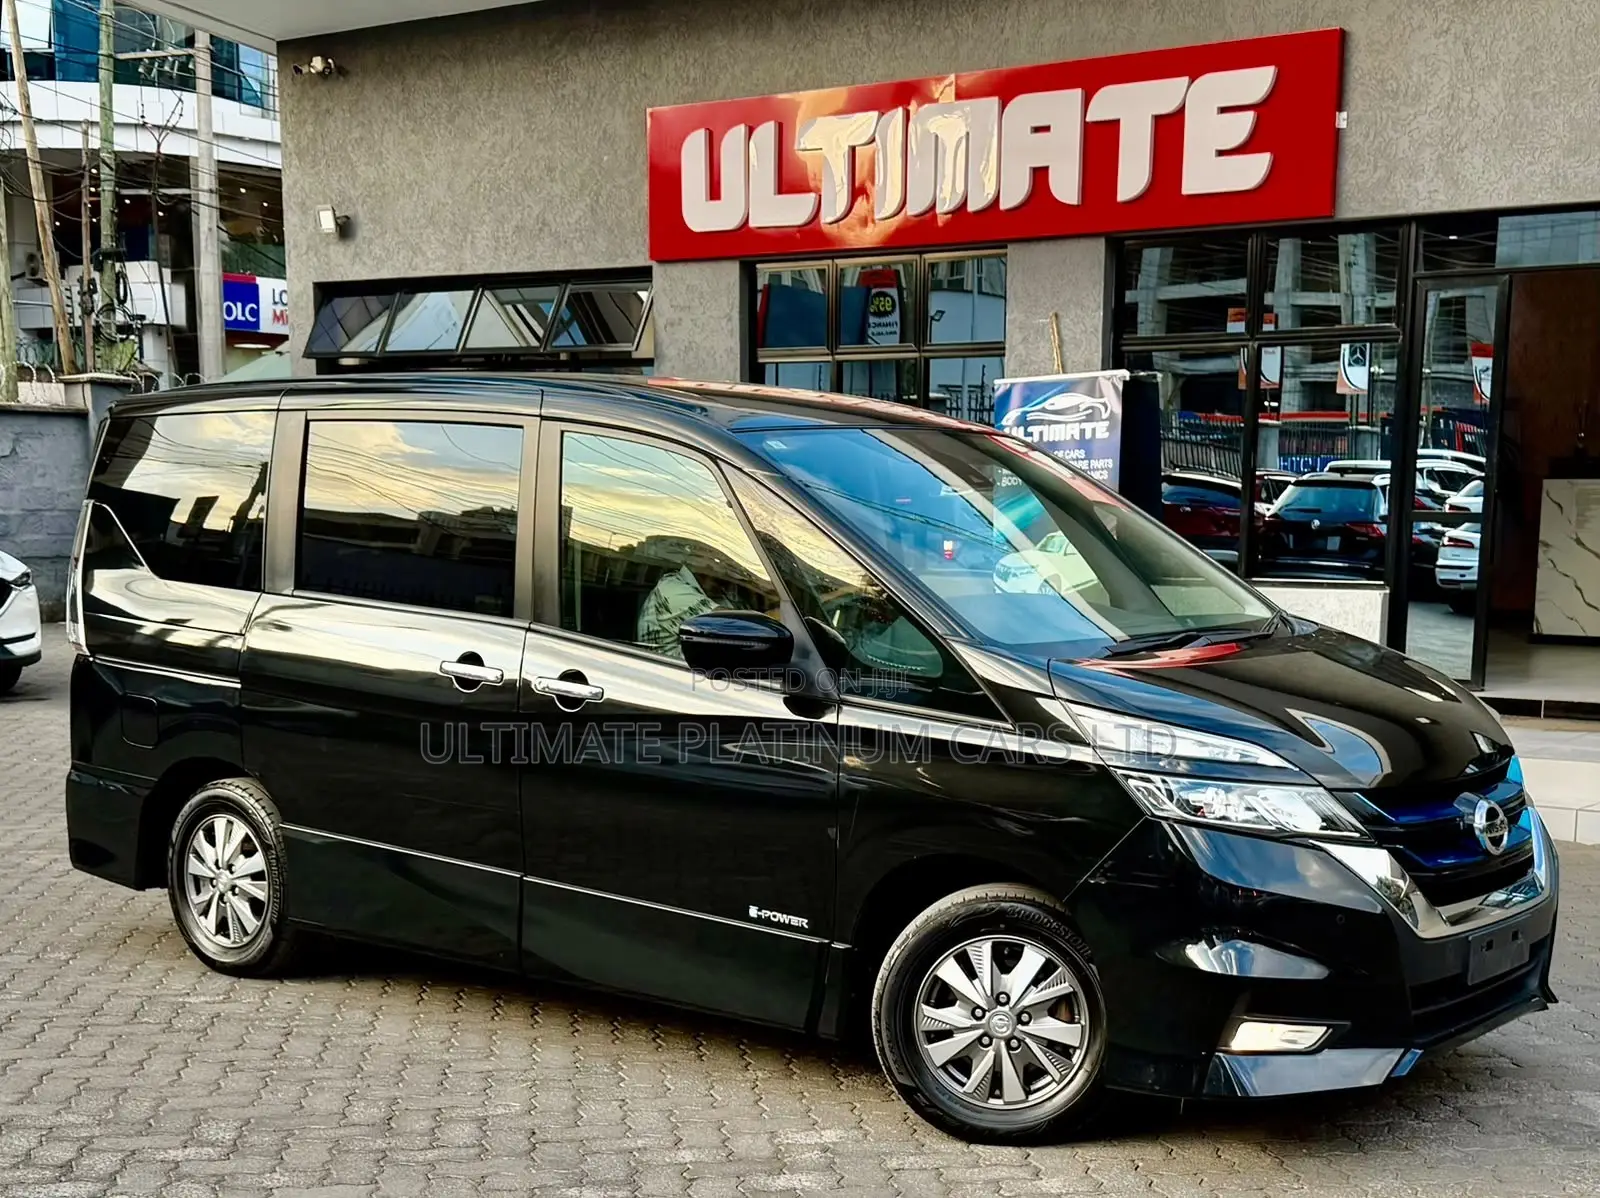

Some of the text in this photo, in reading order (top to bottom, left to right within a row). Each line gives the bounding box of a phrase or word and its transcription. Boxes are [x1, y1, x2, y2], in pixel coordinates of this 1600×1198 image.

[680, 65, 1278, 231] ULTIMATE
[1065, 448, 1086, 459] CARS
[1090, 458, 1113, 469] PARTS
